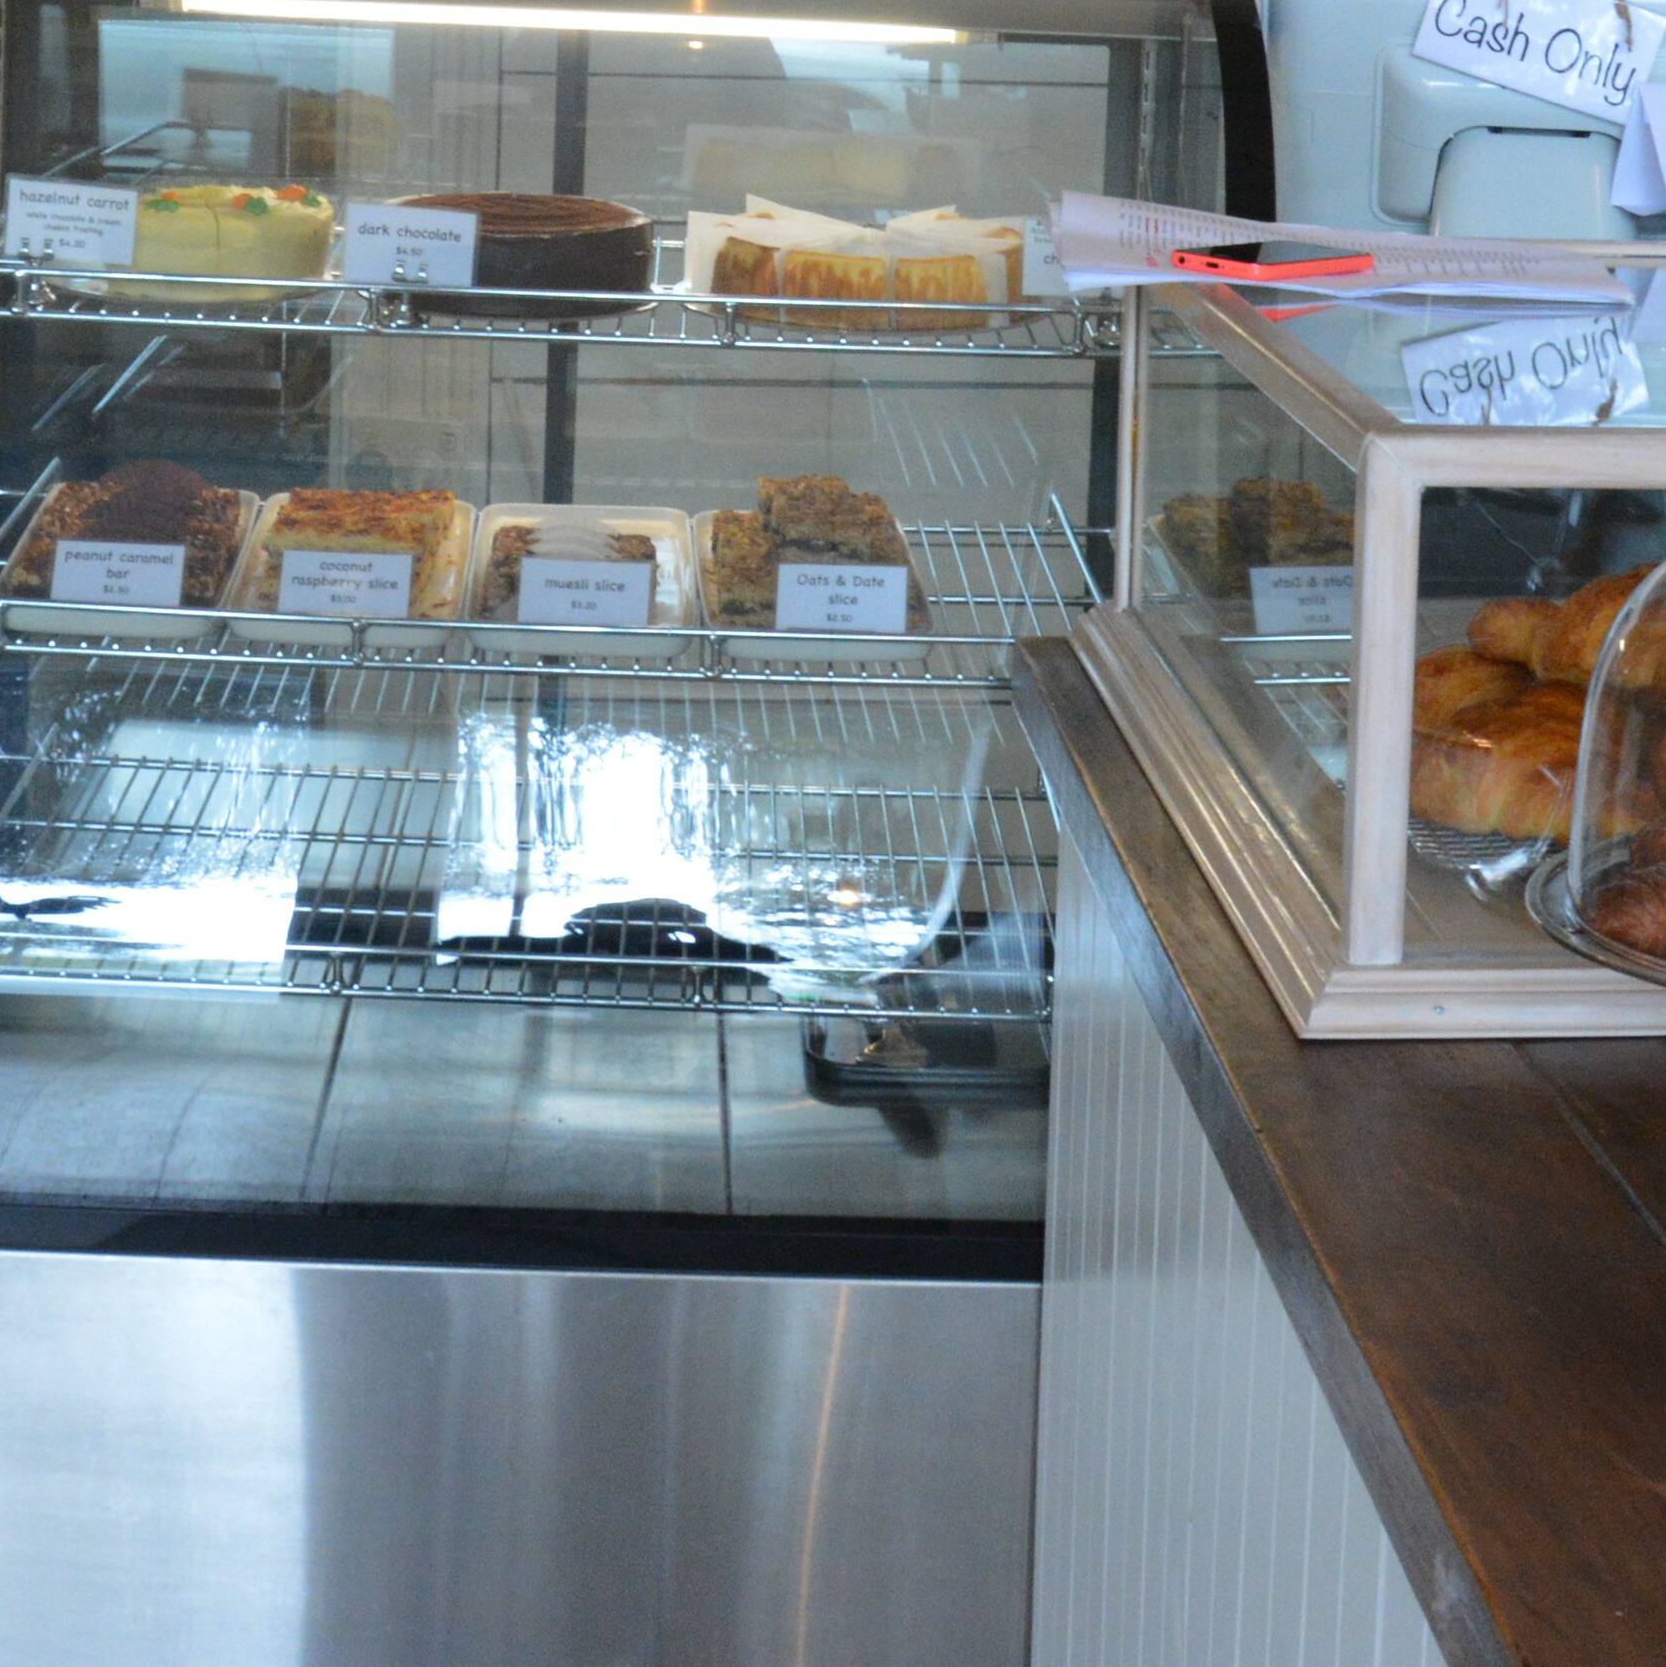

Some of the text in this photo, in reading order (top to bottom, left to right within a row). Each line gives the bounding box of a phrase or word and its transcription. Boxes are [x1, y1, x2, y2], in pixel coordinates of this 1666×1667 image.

[1545, 27, 1637, 106] Only
[18, 189, 130, 211] hazelnut carrot
[357, 223, 462, 243] dark chocolate
[64, 550, 173, 565] peanut caramel
[106, 568, 131, 579] bar
[319, 561, 373, 572] coconut
[292, 574, 399, 590] raspberry slice
[544, 578, 626, 592] muesli slice
[796, 573, 885, 588] Oats & Date
[827, 593, 859, 606] slice
